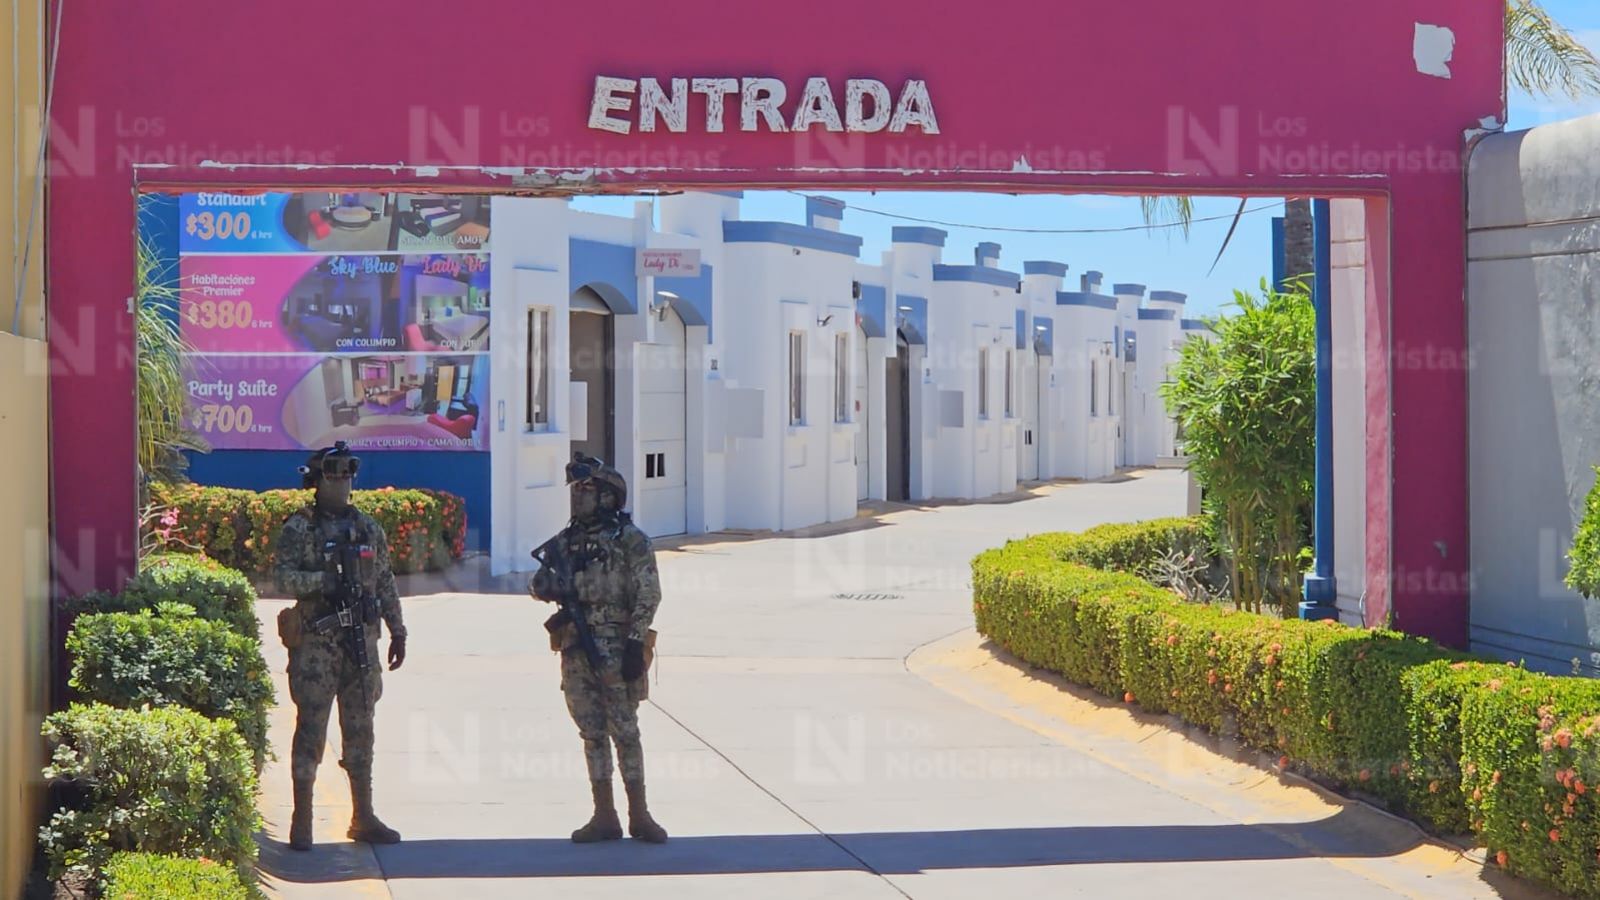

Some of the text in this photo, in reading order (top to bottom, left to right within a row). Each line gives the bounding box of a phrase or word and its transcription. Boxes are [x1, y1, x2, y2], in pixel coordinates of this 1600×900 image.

[588, 76, 940, 135] ENTRADA
[186, 211, 250, 240] $300
[258, 230, 272, 239] hrs
[328, 255, 398, 279] Sky Blue
[422, 256, 485, 278] Lady Di
[203, 286, 244, 296] Premier
[188, 300, 272, 329] $380 6 hrs
[336, 338, 396, 347] CON COLUMPIO
[440, 339, 457, 348] CON
[187, 379, 277, 401] Party Suite
[192, 405, 253, 433] $700
[258, 424, 272, 433] hrs
[377, 439, 418, 448] COLUMPIO
[428, 438, 453, 447] CAMA
